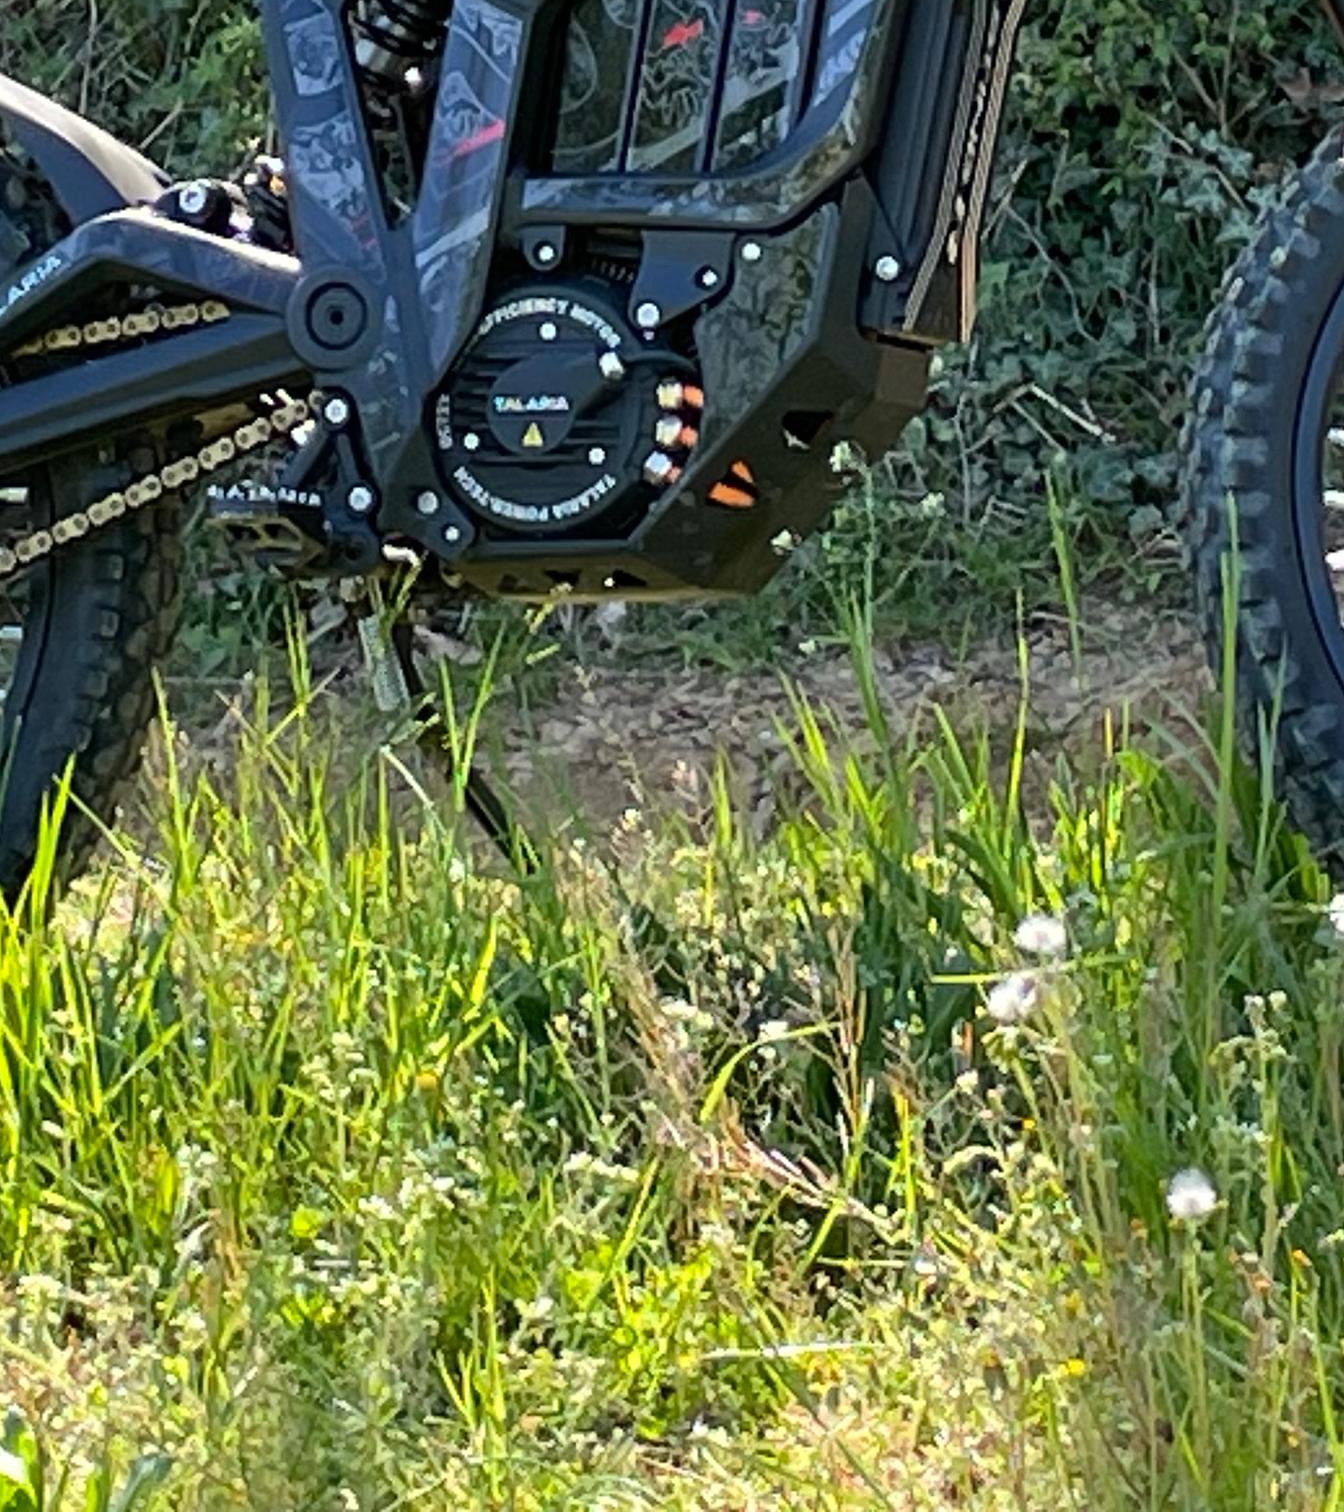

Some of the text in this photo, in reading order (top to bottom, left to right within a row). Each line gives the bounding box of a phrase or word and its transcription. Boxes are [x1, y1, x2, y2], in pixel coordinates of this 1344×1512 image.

[570, 303, 622, 349] MOTOR
[494, 395, 570, 413] TALARIA
[552, 474, 617, 520] TALARIA
